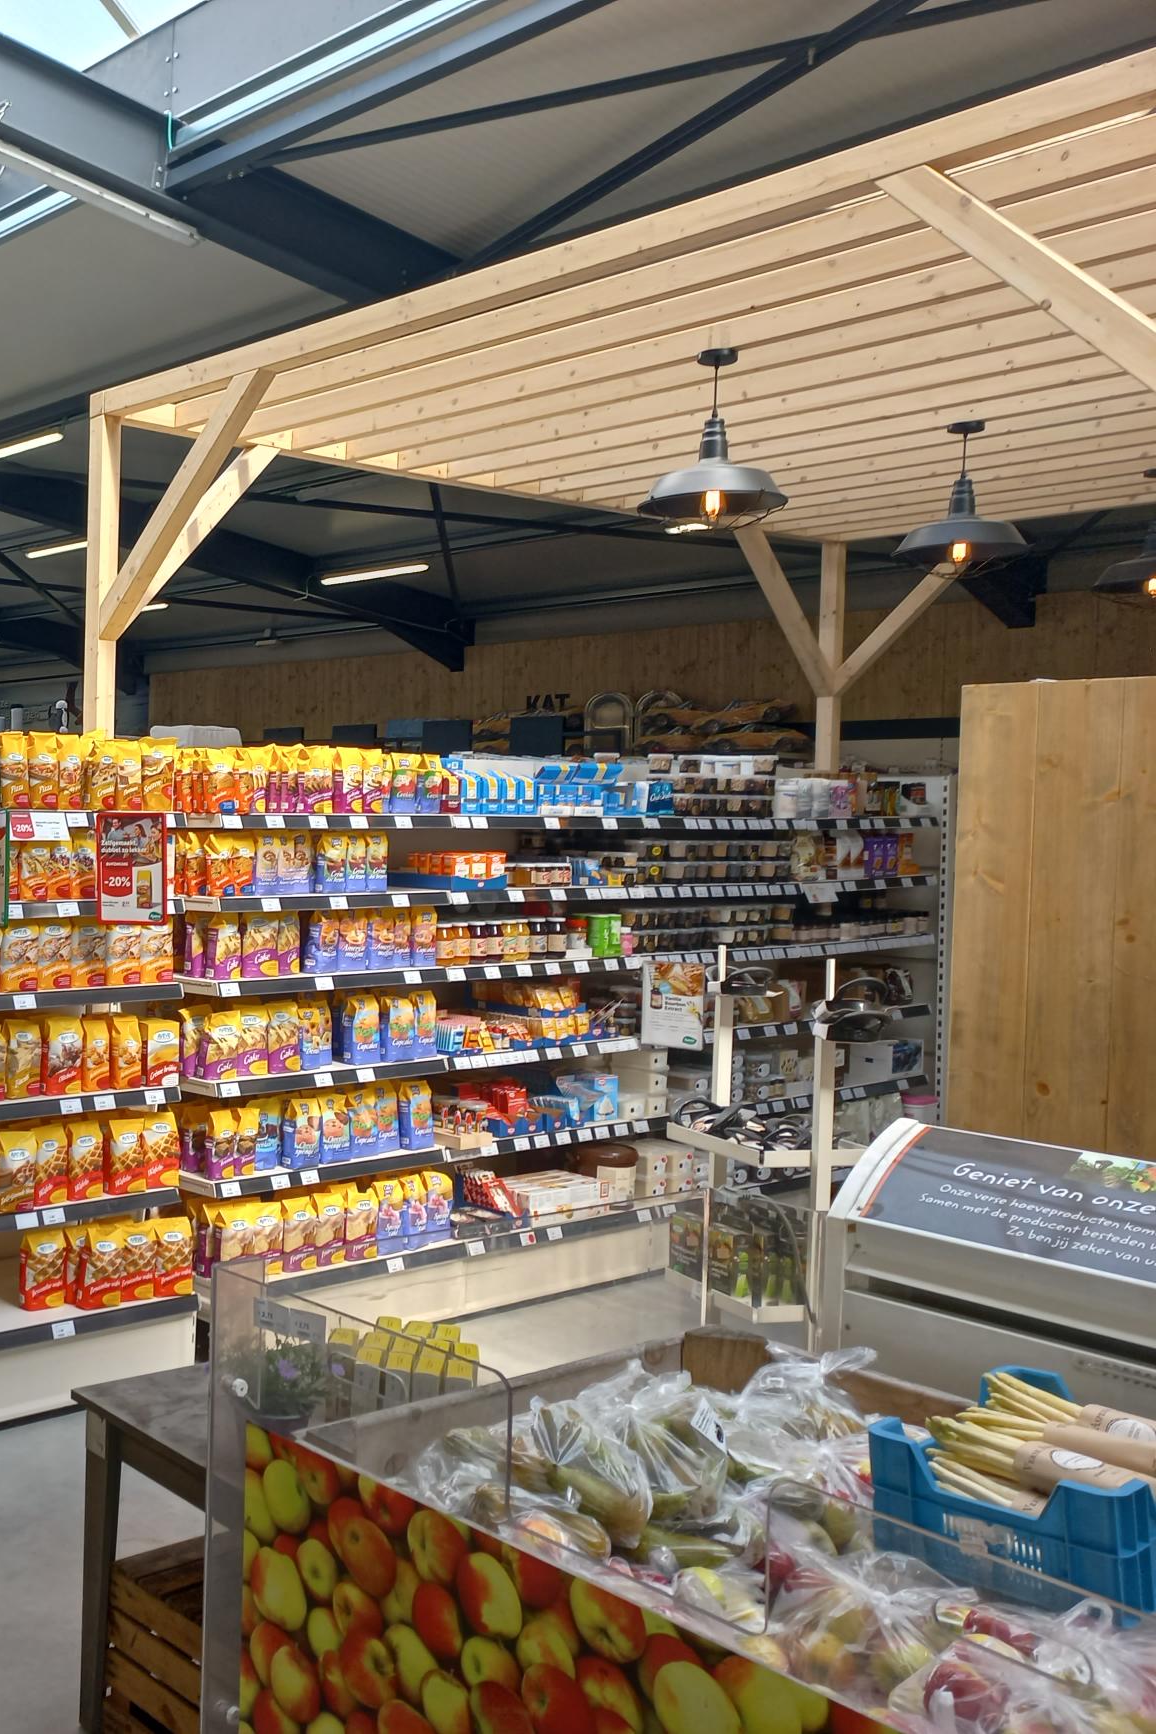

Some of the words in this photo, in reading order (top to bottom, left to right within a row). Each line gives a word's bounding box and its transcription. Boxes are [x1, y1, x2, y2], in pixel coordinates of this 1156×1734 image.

[526, 694, 570, 712] KAT
[13, 824, 33, 833] -20%
[104, 876, 131, 887] -20%
[255, 953, 271, 964] Cake
[244, 1053, 260, 1065] Cake
[280, 1048, 295, 1060] Cake
[217, 1061, 233, 1073] Cake
[953, 1162, 1037, 1190] Geniet
[1039, 1184, 1084, 1202] van
[1091, 1196, 1156, 1215] onze
[939, 1184, 972, 1197] Onze
[974, 1192, 1008, 1205] verse
[1009, 1198, 1119, 1229] hoeveproducten
[918, 1193, 959, 1209] Samen
[962, 1204, 990, 1214] met
[990, 1208, 1008, 1219] de
[1008, 1214, 1081, 1234] producent
[1082, 1226, 1146, 1249] besteden
[1006, 1225, 1025, 1237] Zo
[1027, 1229, 1051, 1244] ben
[1051, 1236, 1070, 1250] jij
[1071, 1241, 1113, 1257] zeker
[1115, 1251, 1141, 1263] van
